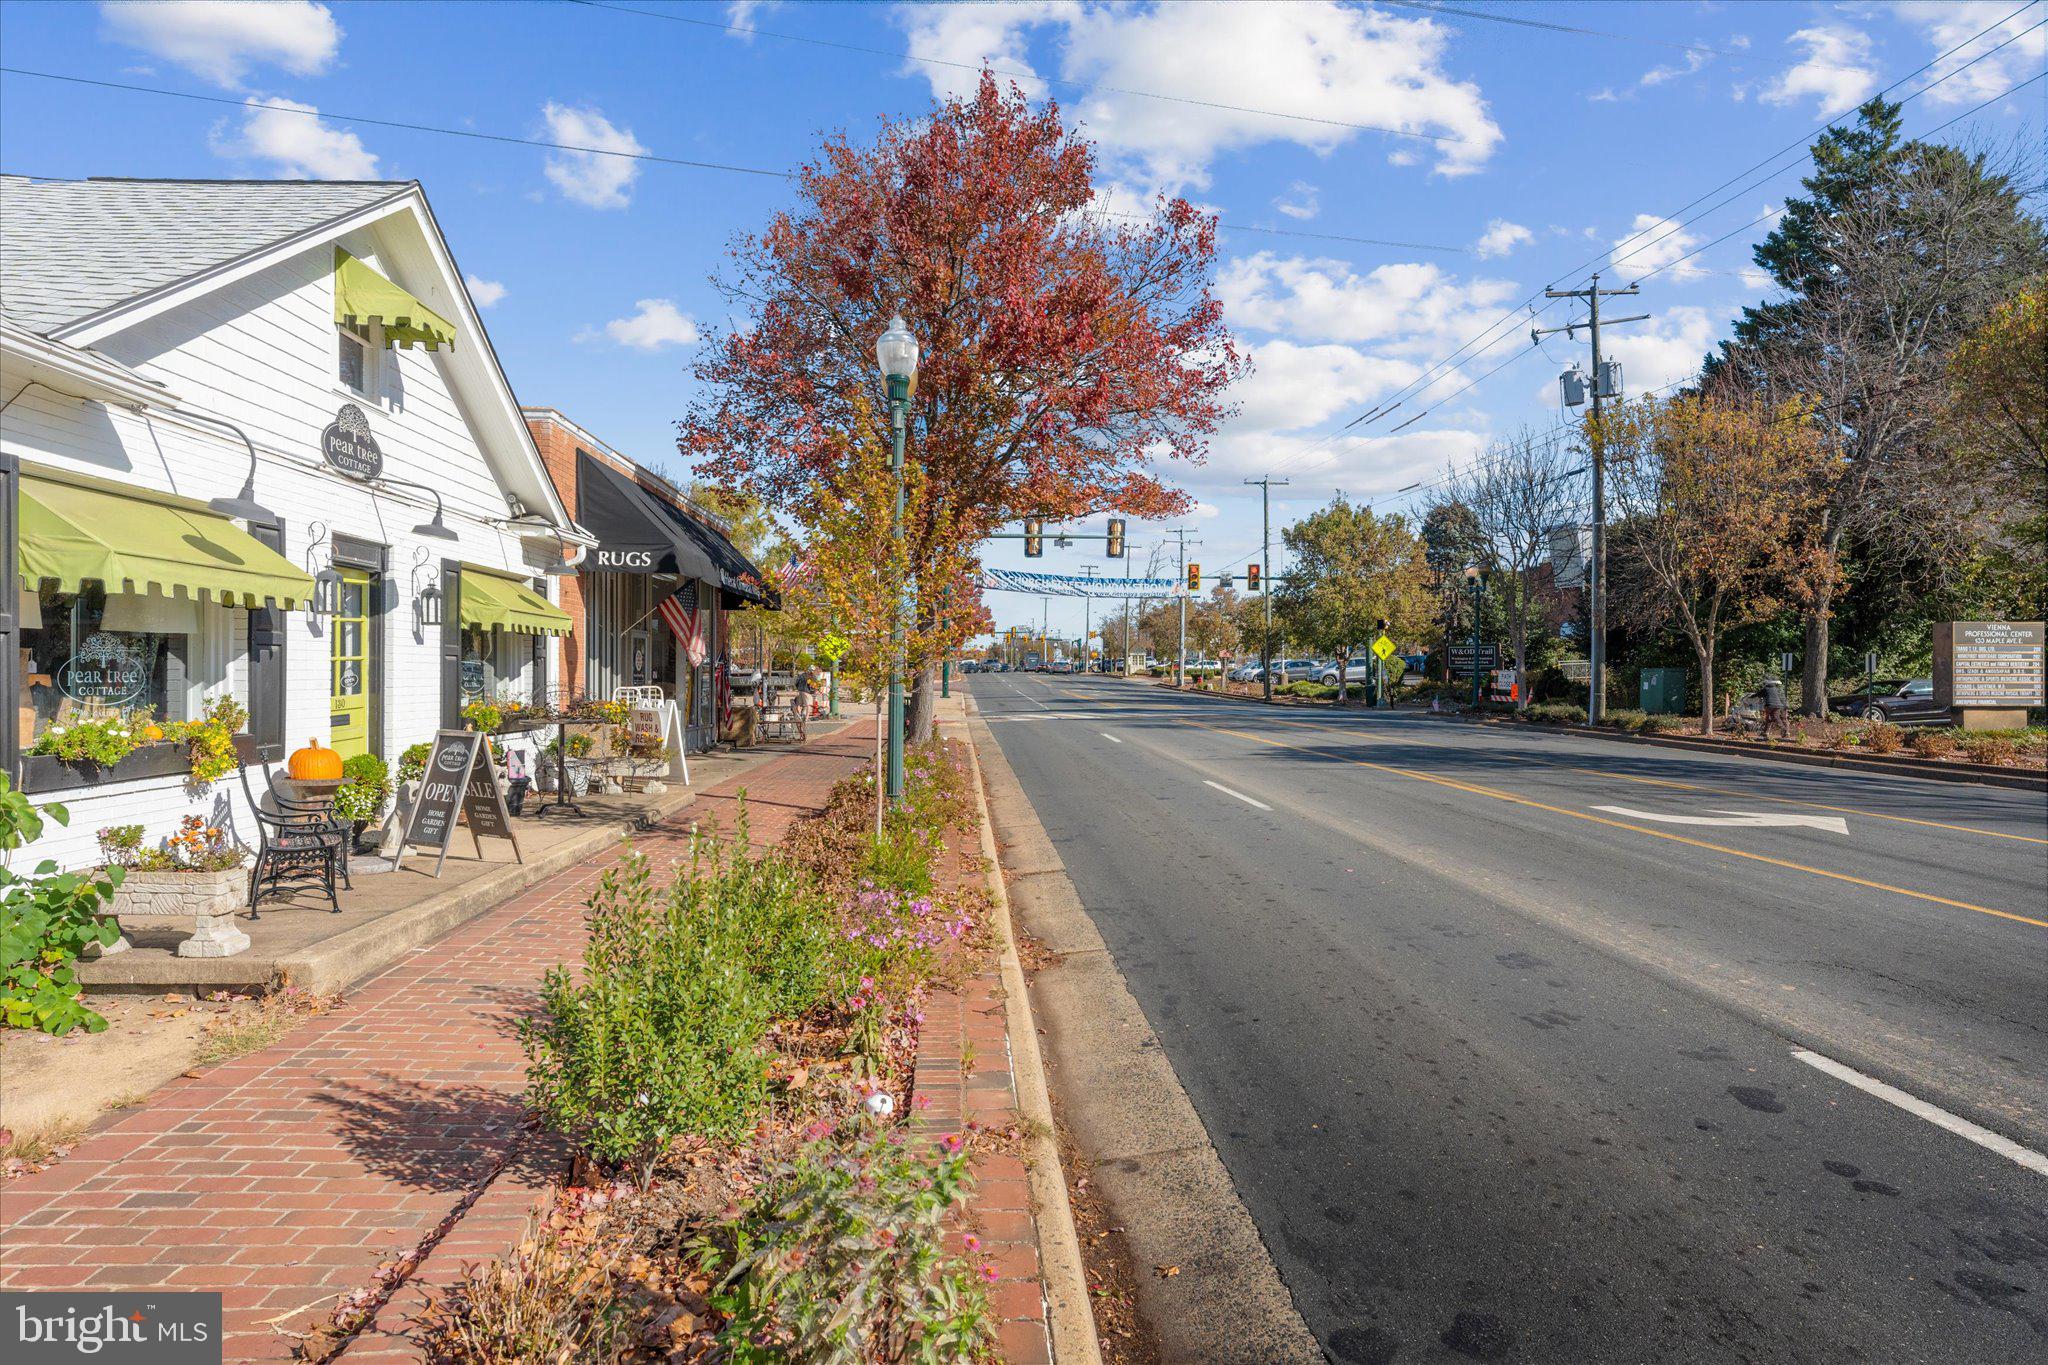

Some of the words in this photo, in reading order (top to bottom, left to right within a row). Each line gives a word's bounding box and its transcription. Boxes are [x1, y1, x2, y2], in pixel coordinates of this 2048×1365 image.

[338, 455, 372, 474] COTTAGE
[598, 551, 651, 567] RUGS
[1964, 630, 2009, 638] PROFESSIONAL
[78, 686, 127, 696] COTTAGE
[640, 712, 653, 722] RUG
[635, 723, 653, 732] WASH
[654, 723, 659, 733] &
[425, 782, 460, 803] OPEN
[474, 804, 492, 812] HOME
[427, 809, 446, 818] HOME
[474, 812, 497, 820] GARDEN
[421, 817, 446, 827] GARDEN
[423, 827, 439, 835] GIFT
